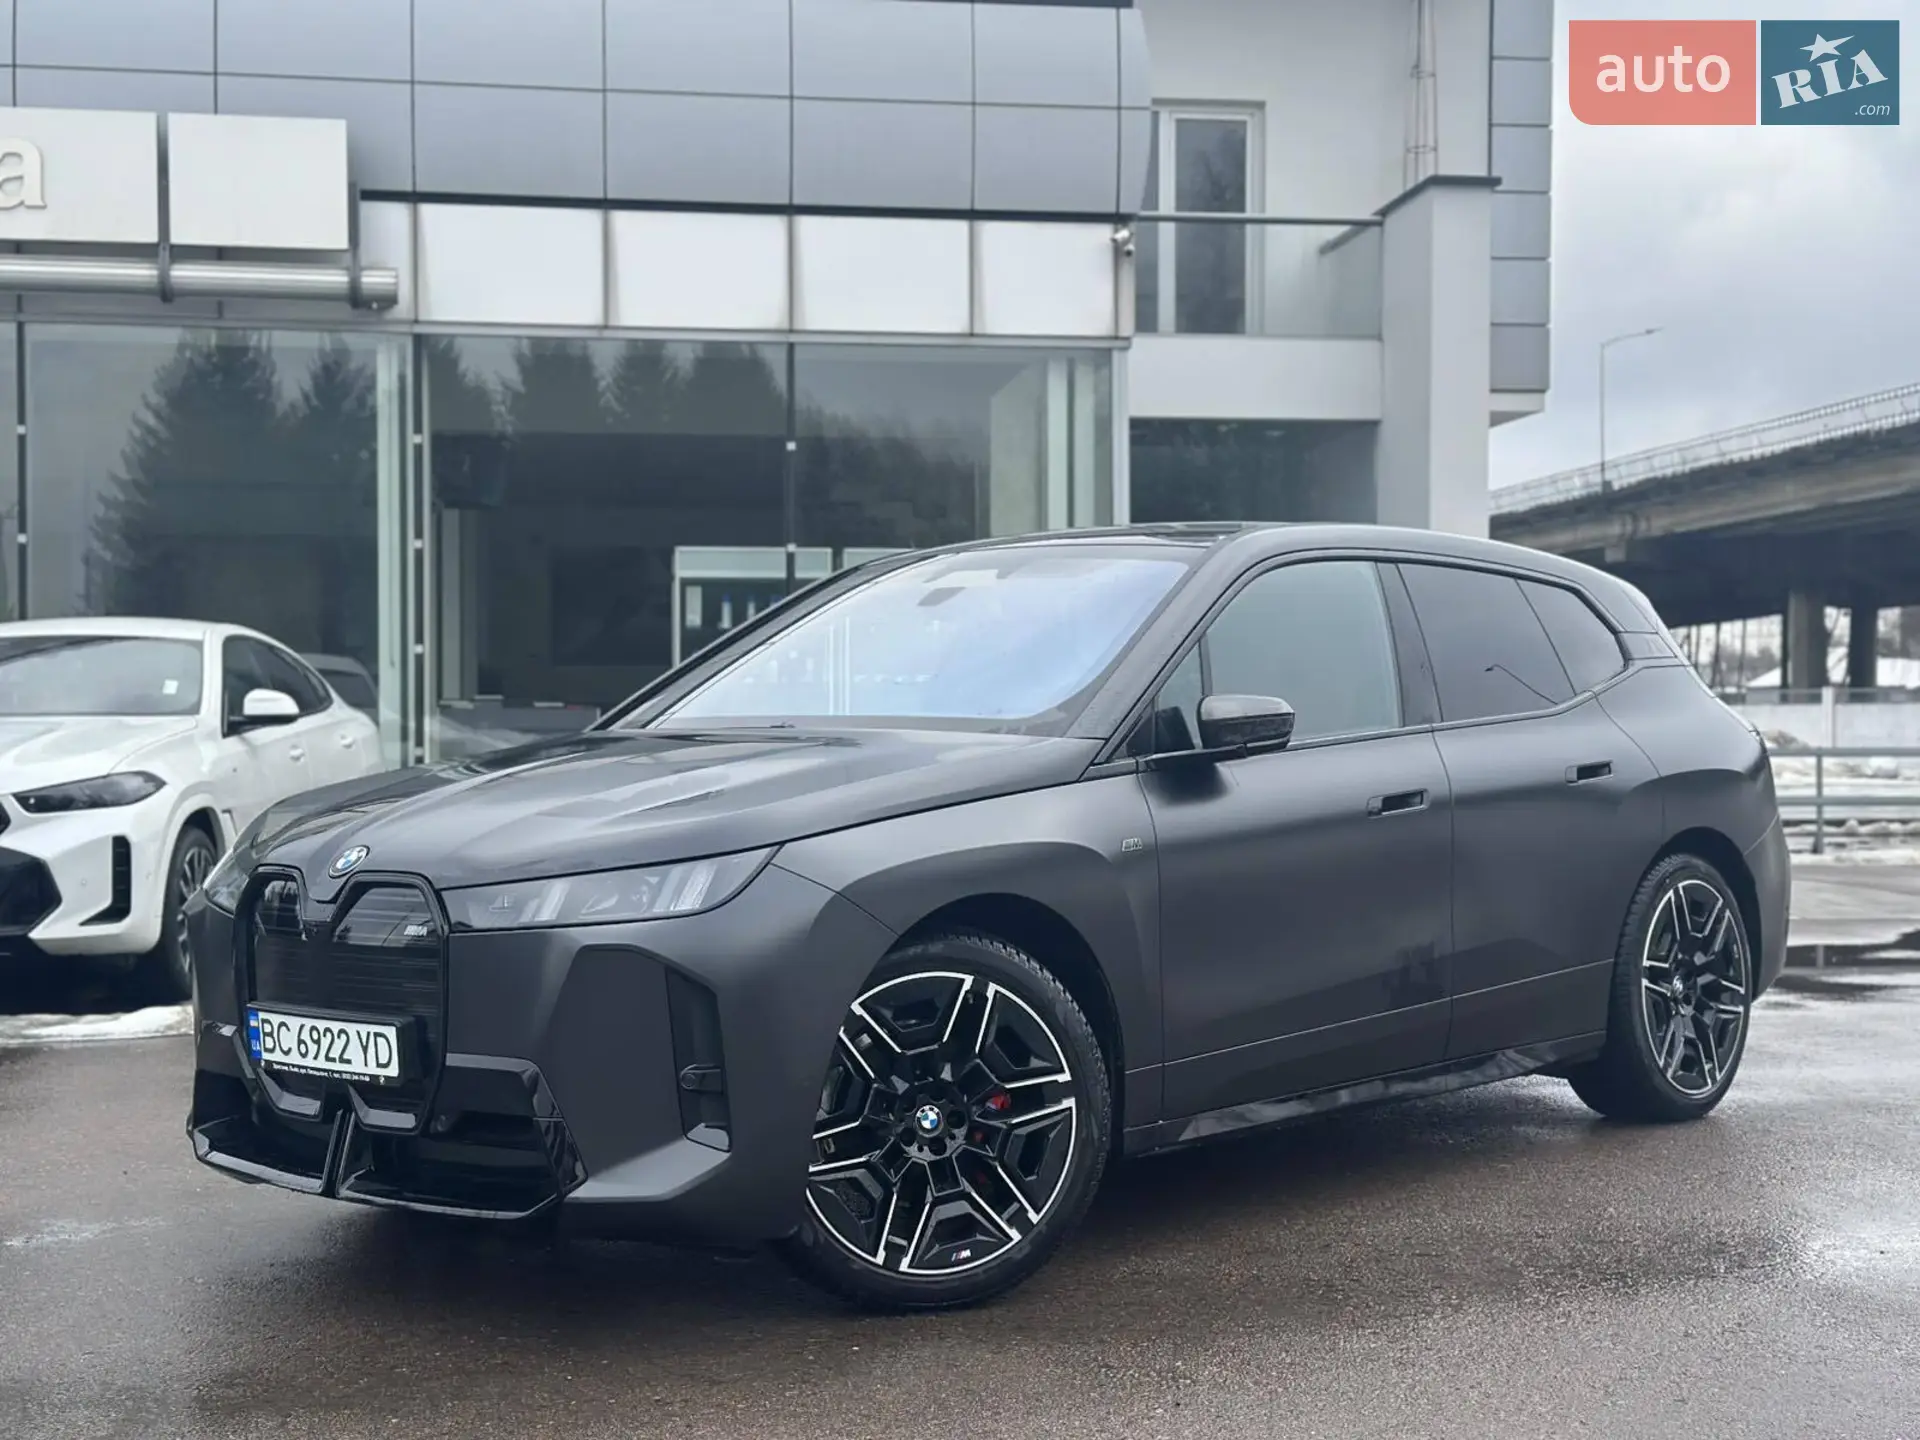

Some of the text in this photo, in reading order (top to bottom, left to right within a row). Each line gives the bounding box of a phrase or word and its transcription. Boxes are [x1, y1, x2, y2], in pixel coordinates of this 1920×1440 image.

[260, 1018, 393, 1069] BC 6922 YD
